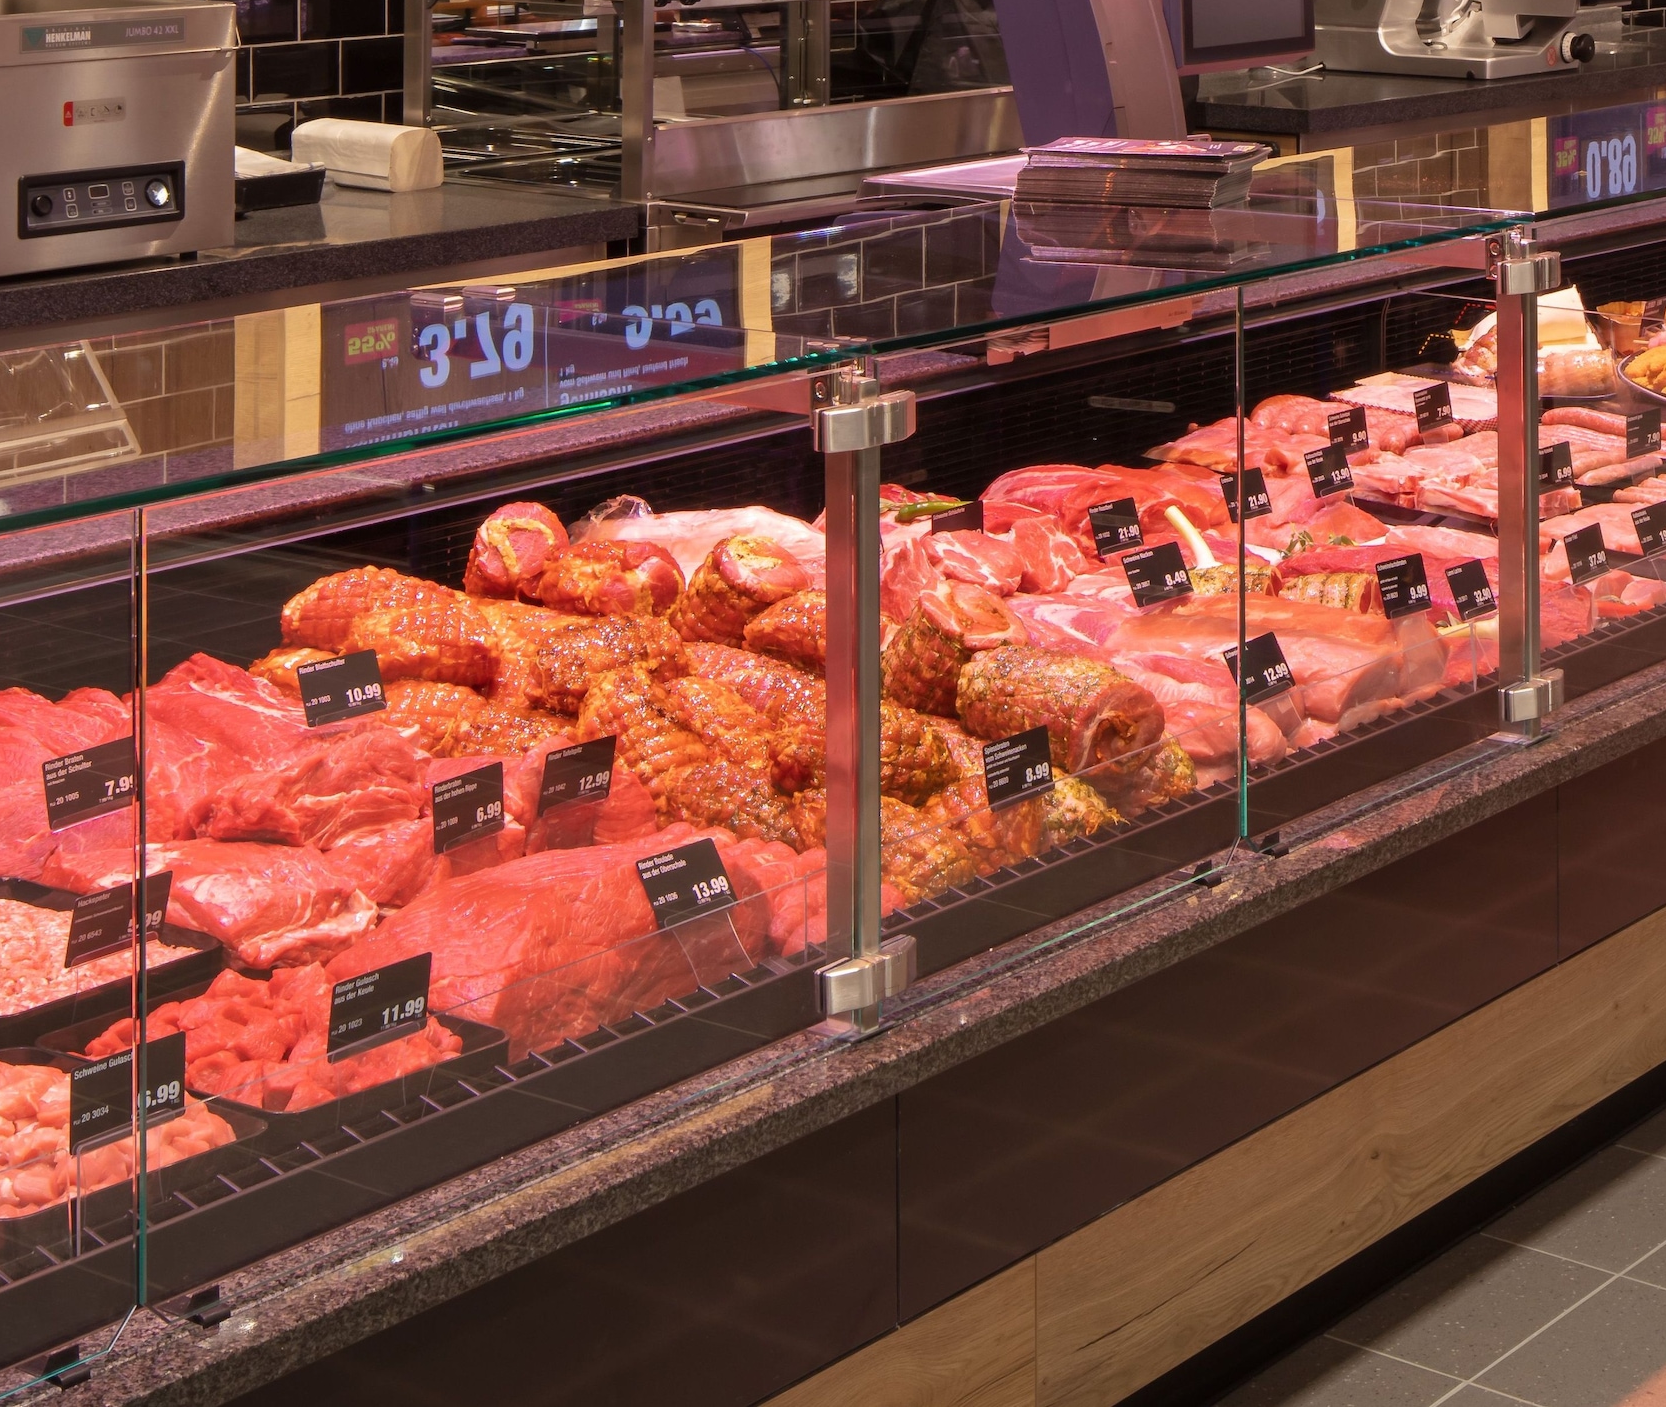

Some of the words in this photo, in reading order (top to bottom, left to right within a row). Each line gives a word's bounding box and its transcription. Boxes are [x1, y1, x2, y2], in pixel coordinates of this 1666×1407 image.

[45, 31, 91, 44] HENKELMAN
[126, 26, 152, 38] JUMBO
[153, 26, 163, 36] 42
[165, 25, 179, 34] XXL
[1437, 405, 1451, 417] 7.90
[1353, 430, 1367, 442] 9.90
[1647, 432, 1660, 444] 7.90
[1331, 468, 1350, 481] 13.90
[1557, 466, 1572, 479] 6.99
[1248, 493, 1268, 508] 21.90
[1118, 525, 1140, 540] 21.90
[1588, 551, 1606, 567] 37.90
[1165, 570, 1187, 586] 8.49
[1410, 584, 1428, 599] 9.99
[1473, 587, 1491, 603] 32.90
[1263, 662, 1289, 682] 12.99
[346, 683, 381, 702] 10.99
[1026, 762, 1049, 782] 8.99
[579, 771, 610, 790] 12.99
[476, 801, 501, 822] 6.99
[692, 875, 729, 900] 13.99
[382, 996, 425, 1025] 11.99
[74, 1062, 108, 1080] Schweine
[81, 1112, 91, 1123] 20
